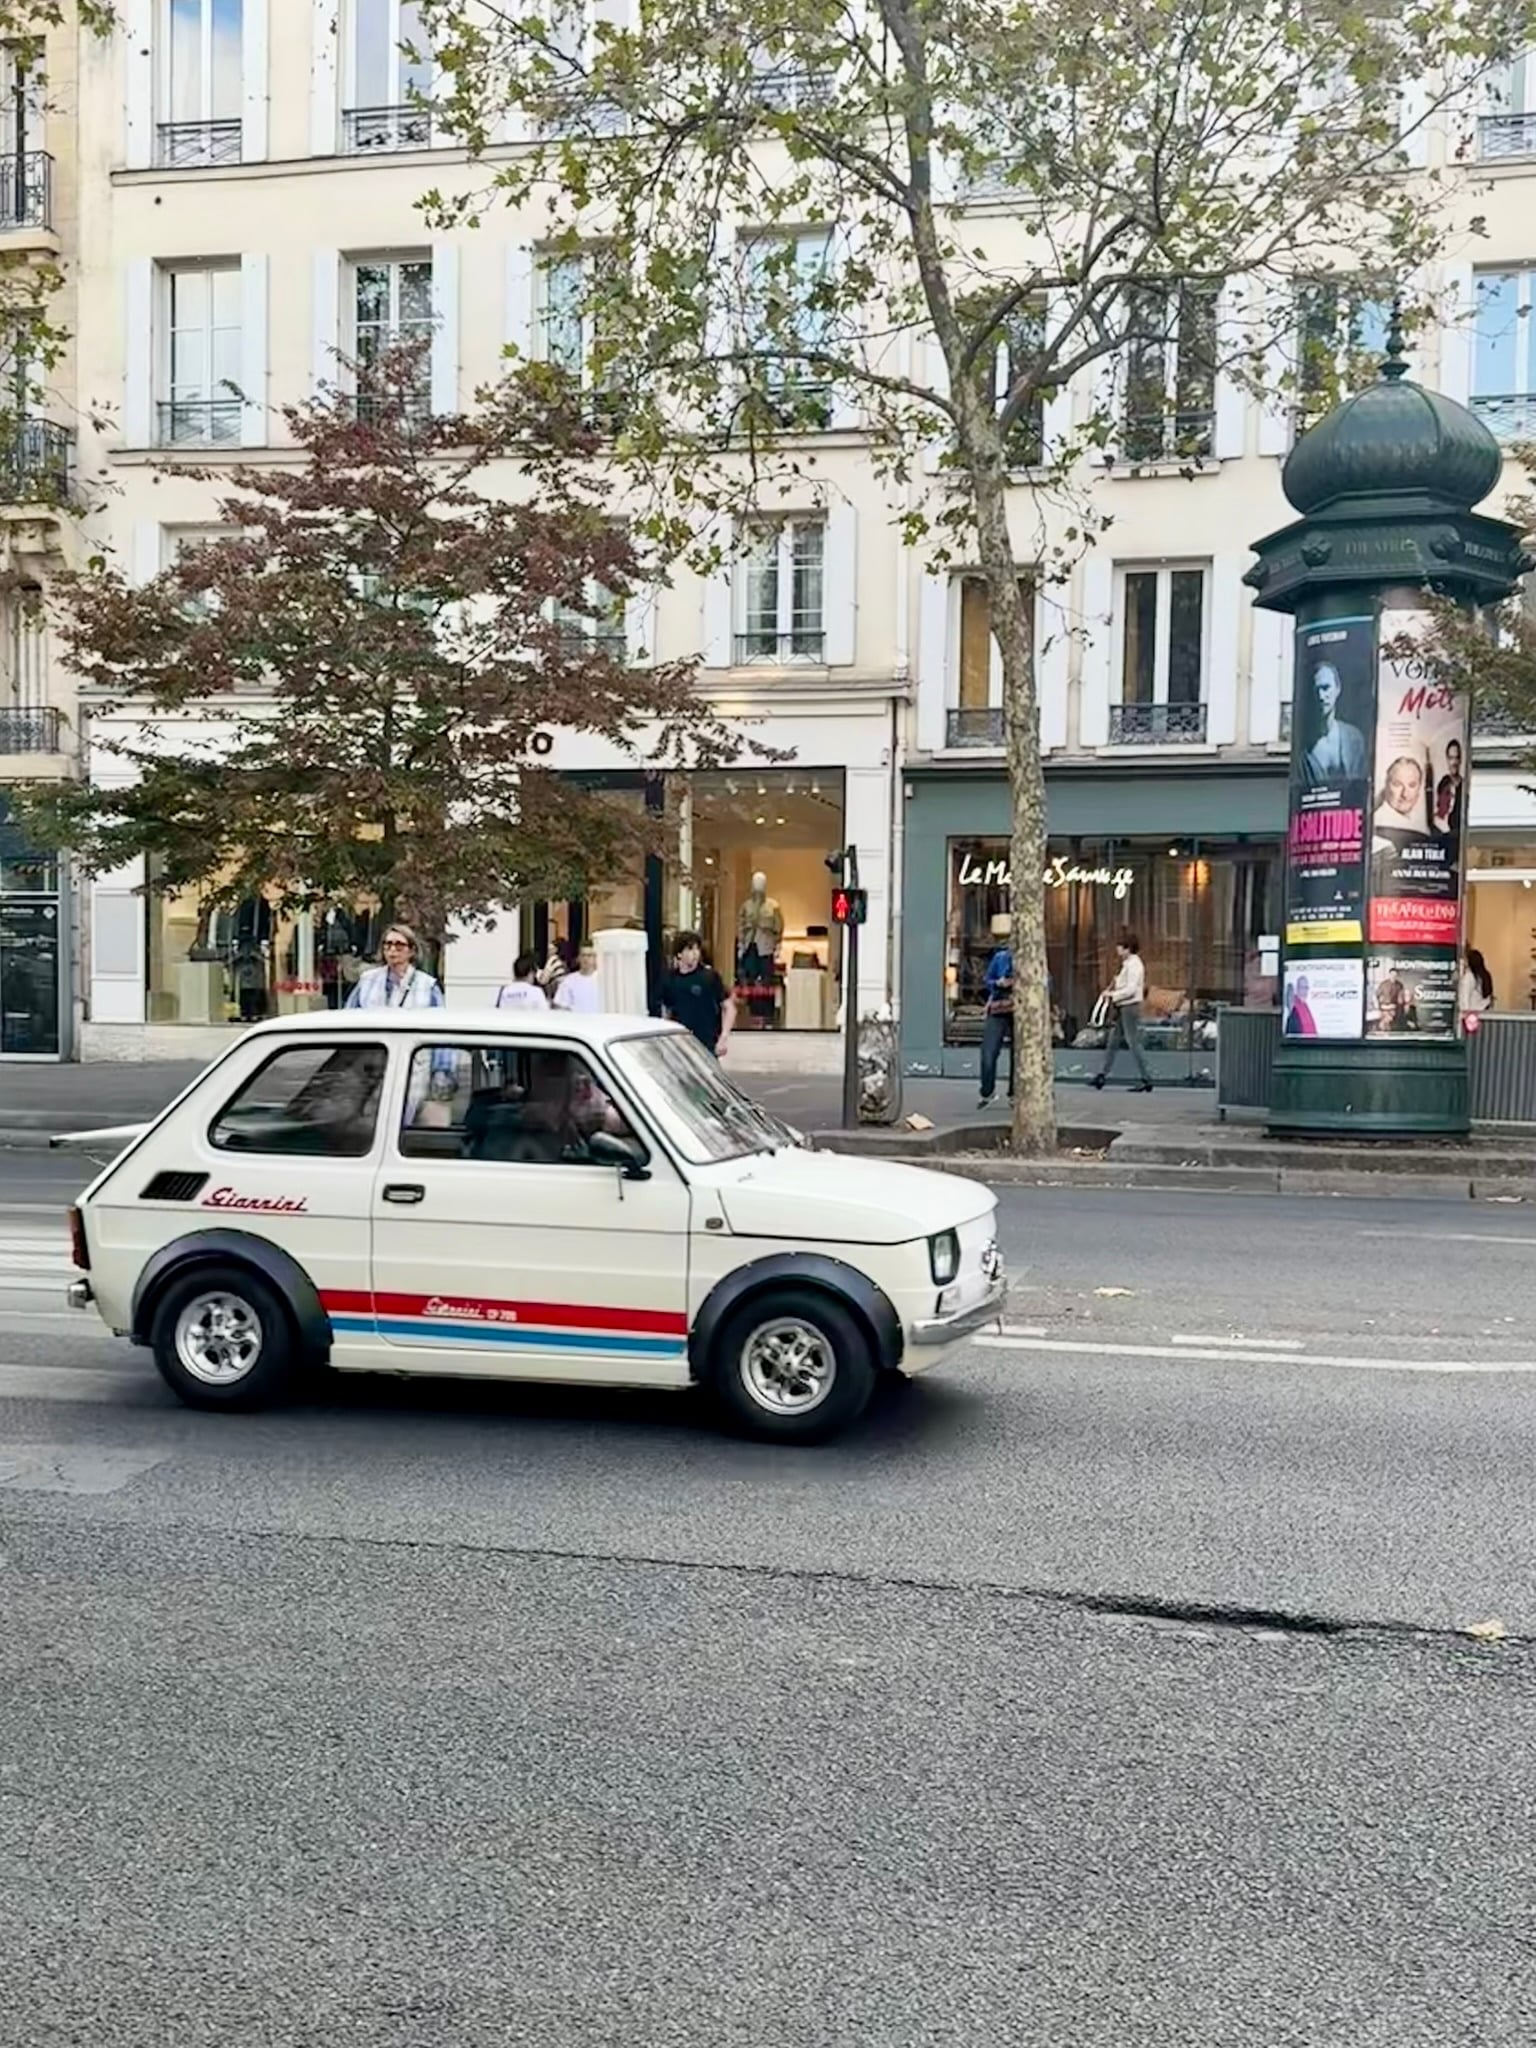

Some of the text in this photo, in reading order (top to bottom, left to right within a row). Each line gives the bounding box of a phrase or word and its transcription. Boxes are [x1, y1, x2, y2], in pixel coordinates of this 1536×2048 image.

[1398, 686, 1454, 719] Mots
[1300, 808, 1363, 842] SOLITUDE
[959, 854, 982, 885] Le
[201, 1187, 308, 1211] Giannini
